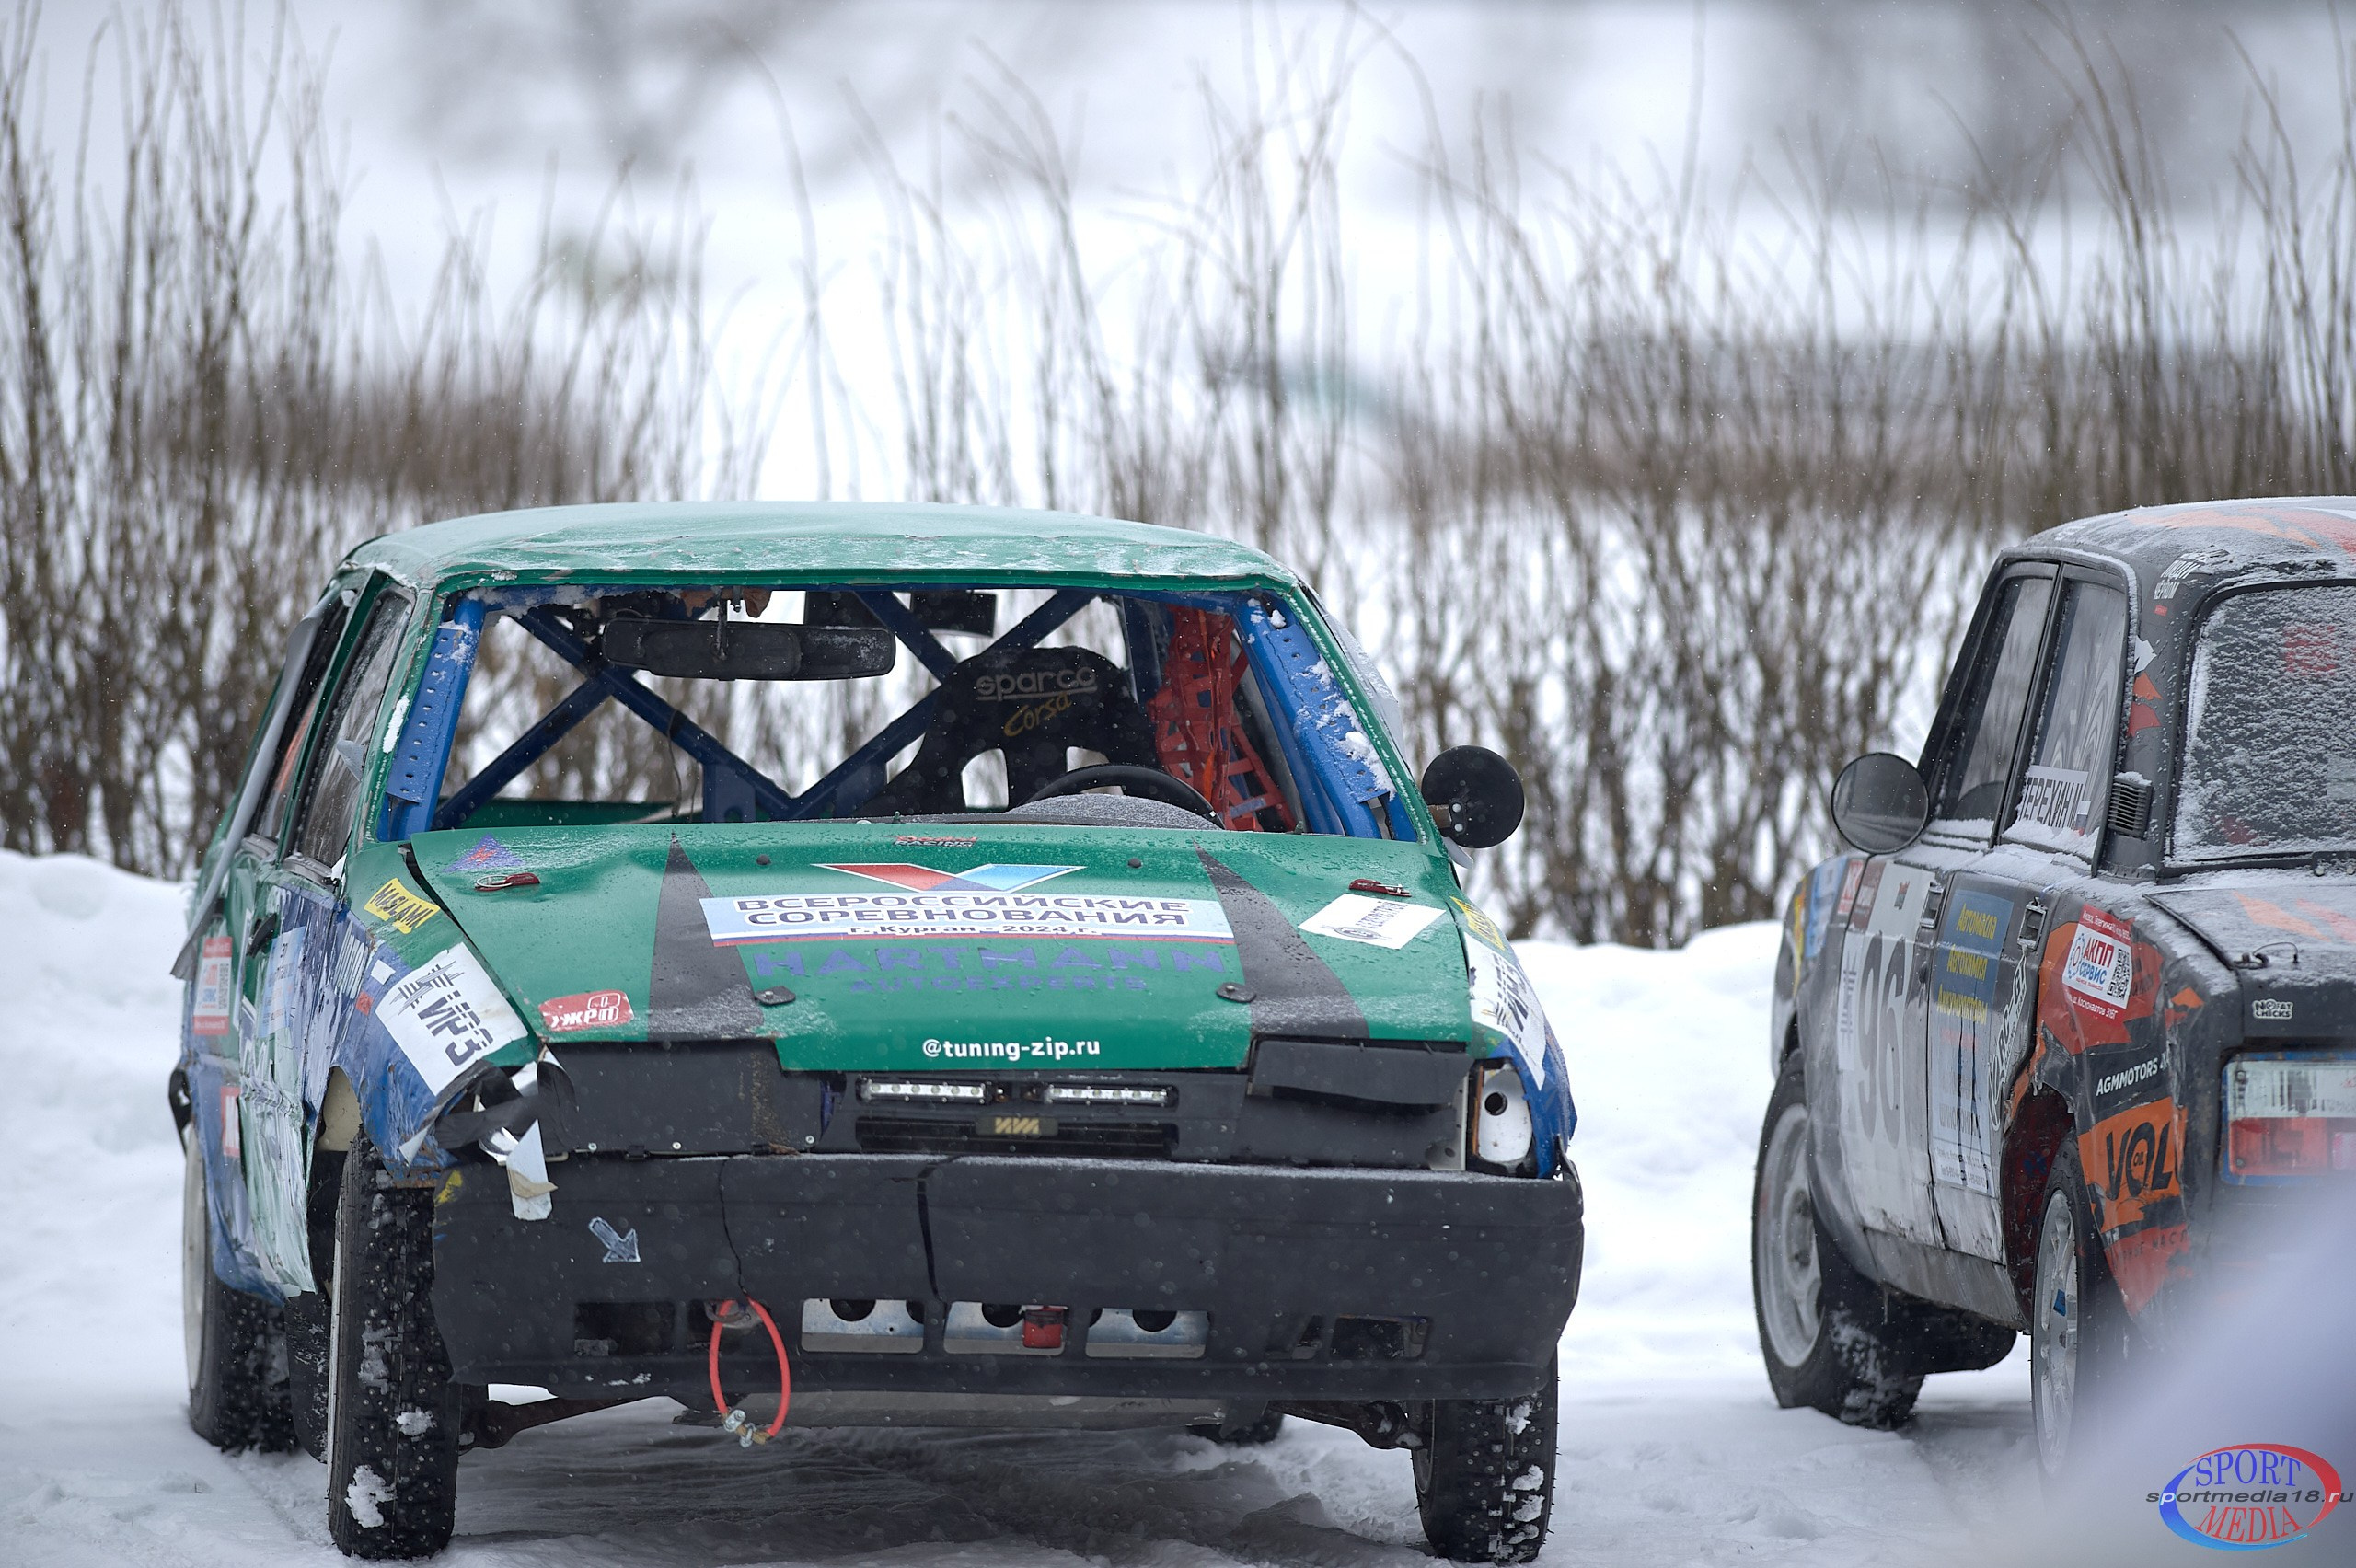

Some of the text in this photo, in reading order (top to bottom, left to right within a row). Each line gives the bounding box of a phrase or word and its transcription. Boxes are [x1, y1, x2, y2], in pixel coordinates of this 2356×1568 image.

[976, 666, 1098, 702] sparco
[1004, 692, 1073, 737] Corsa
[737, 894, 1189, 912] ВСЕРОССИЙСКИЕ
[748, 909, 1185, 925] СОРЕВНОВАНИЯ
[880, 925, 976, 935] Курган
[1003, 925, 1068, 933] 2024
[1956, 903, 1998, 940] Автомасла
[753, 946, 1225, 977] HARTMANN
[1946, 944, 1989, 982] Автохимия
[2083, 937, 2115, 968] АКПП
[850, 975, 1148, 992] AUTOEXPERTS
[2079, 962, 2108, 985] СЕРВИС
[2096, 1056, 2158, 1096] AGMMOTORS
[2133, 1151, 2145, 1167] OIL
